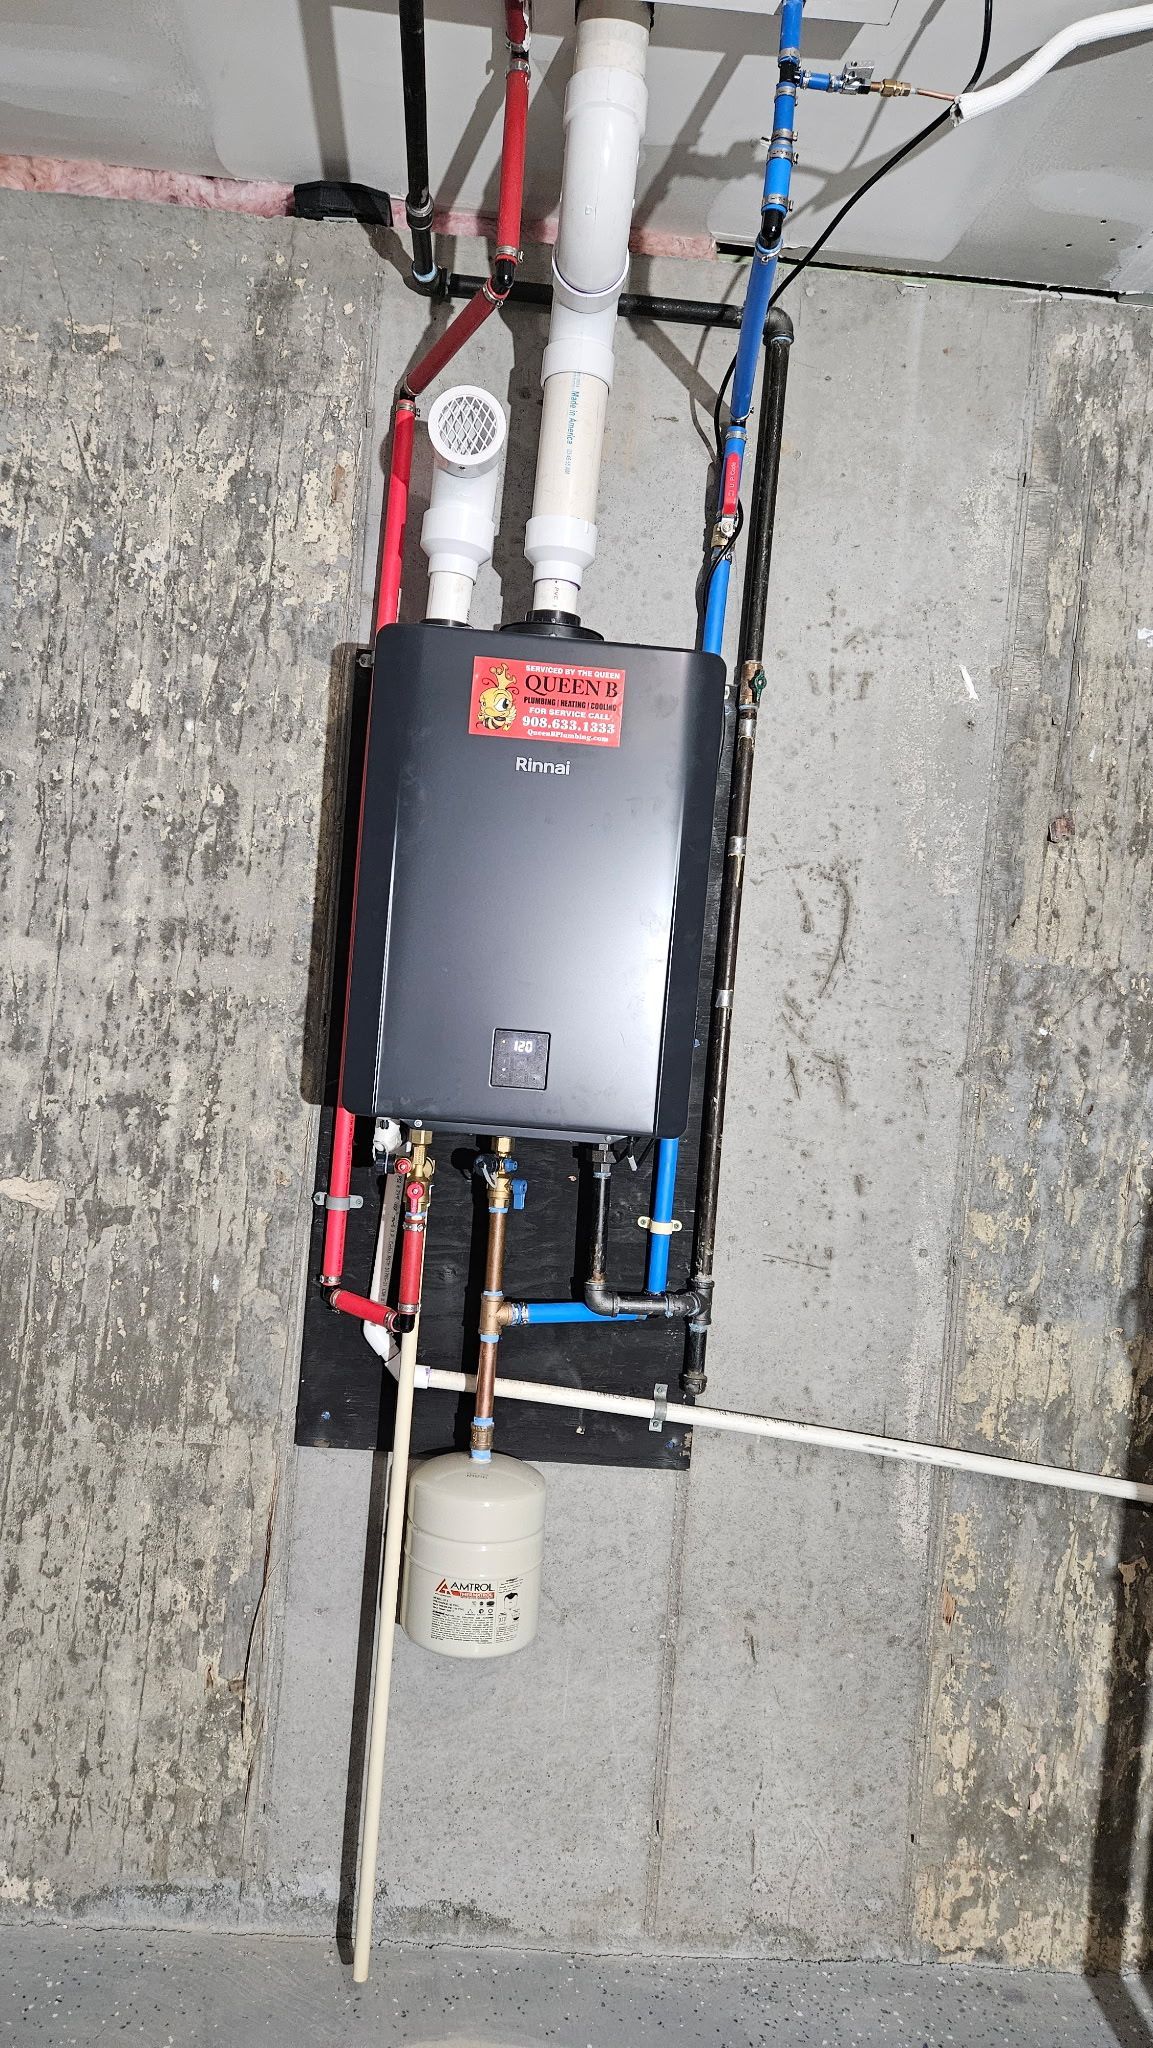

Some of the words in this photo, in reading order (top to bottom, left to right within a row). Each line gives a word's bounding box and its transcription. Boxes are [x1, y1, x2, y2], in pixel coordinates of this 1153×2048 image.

[567, 418, 577, 445] America
[525, 665, 563, 674] SERVICED
[578, 669, 592, 677] THE
[594, 671, 620, 679] QUEEN
[525, 674, 602, 696] QUEEN
[605, 681, 618, 698] B
[524, 696, 556, 706] PLUMBING
[560, 700, 586, 709] HEATING
[590, 702, 617, 711] COOLING
[549, 708, 586, 718] SERVICE
[522, 716, 615, 734] 908.633.1333
[527, 729, 609, 742] QueenBPlumbing.com
[515, 756, 570, 775] Rinnai
[514, 1040, 533, 1053] 120
[450, 1582, 495, 1591] AMTROL
